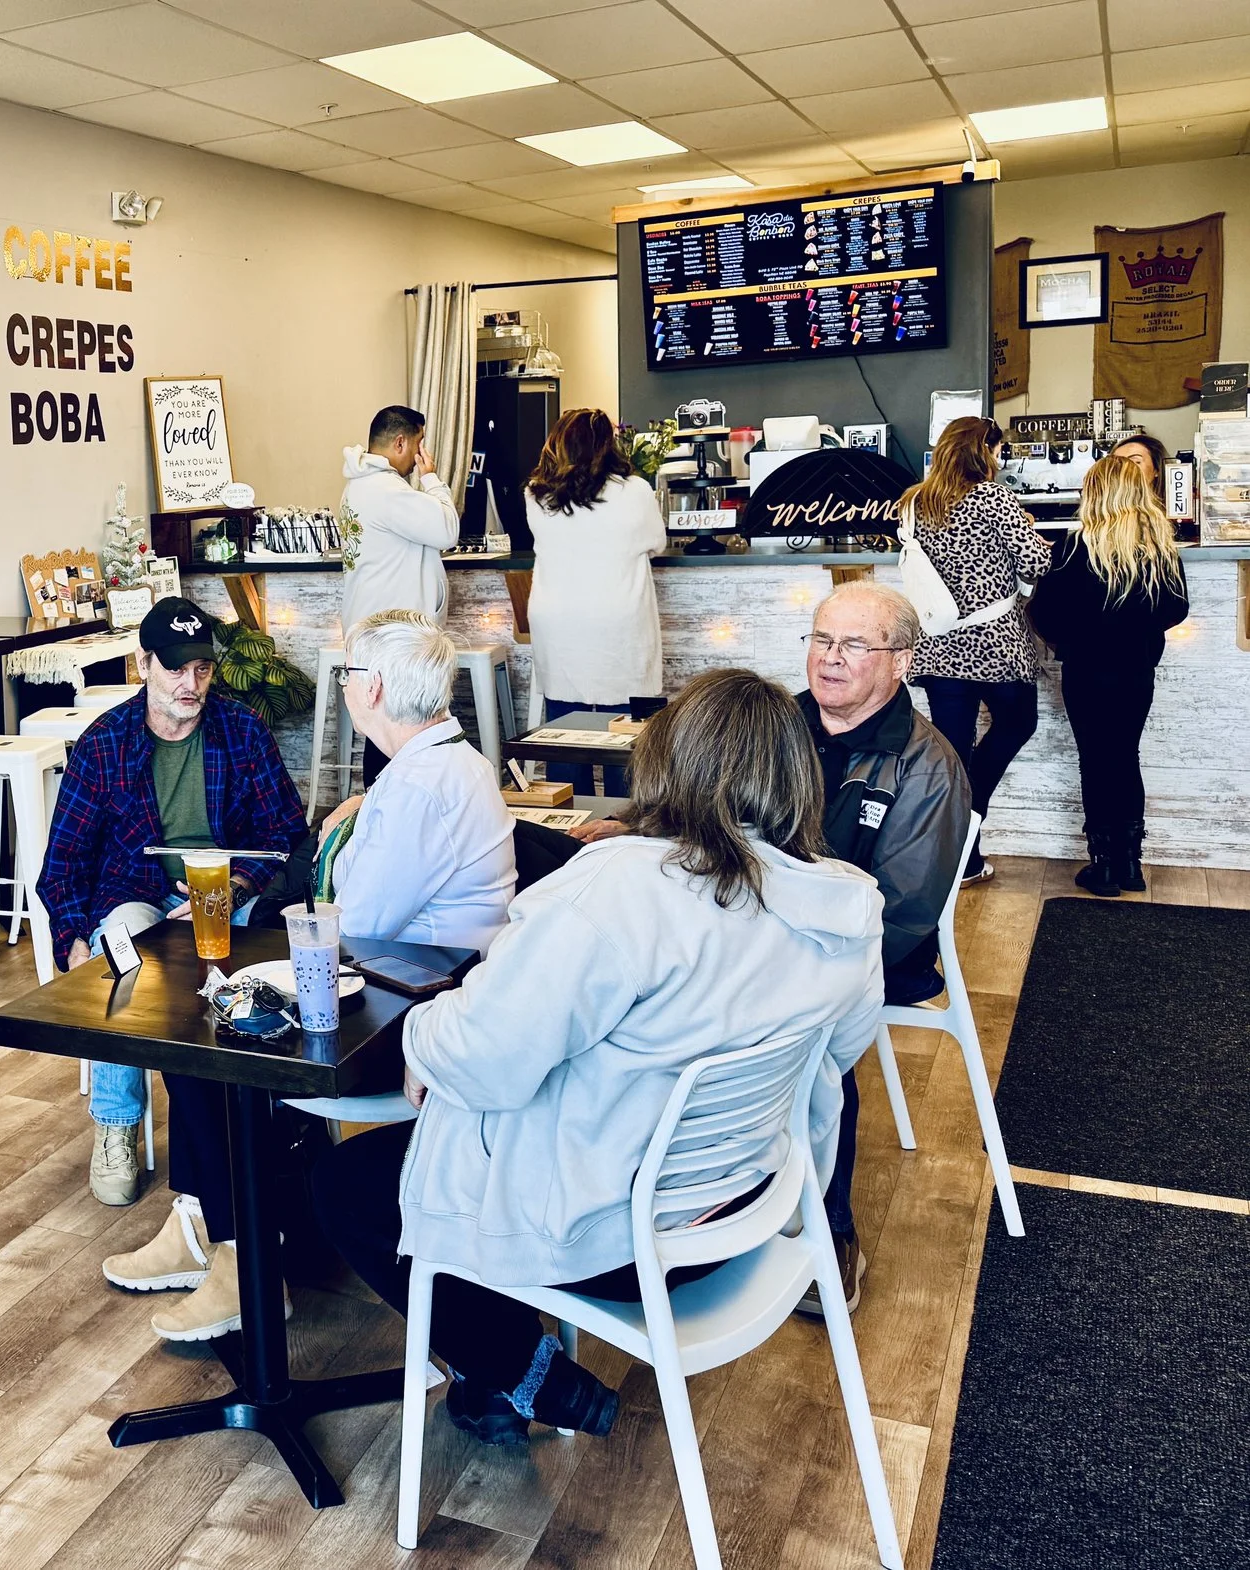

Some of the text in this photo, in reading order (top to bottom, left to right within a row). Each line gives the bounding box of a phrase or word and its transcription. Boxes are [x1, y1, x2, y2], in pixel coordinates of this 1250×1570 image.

[853, 196, 881, 205] CREPES
[675, 220, 700, 228] COFFEE
[747, 213, 783, 227] Kasa
[746, 222, 795, 238] Bonbon
[4, 224, 132, 292] COFFEE
[1133, 263, 1187, 280] ROYAL
[759, 282, 807, 292] BUBBLE TEAS
[1041, 277, 1084, 288] MOCHA
[1142, 285, 1176, 295] SELECT
[772, 293, 801, 301] TOPPINGS
[6, 313, 134, 373] CREPES
[191, 400, 206, 408] ARE
[10, 390, 106, 445] BOBA
[178, 410, 201, 419] MORE
[164, 409, 216, 454] loved
[187, 458, 204, 466] YOU
[206, 457, 224, 465] WILL
[173, 469, 218, 479] EVER KNOW
[1174, 471, 1184, 513] OPEN
[767, 493, 901, 526] welcome
[677, 511, 727, 528] enjoy
